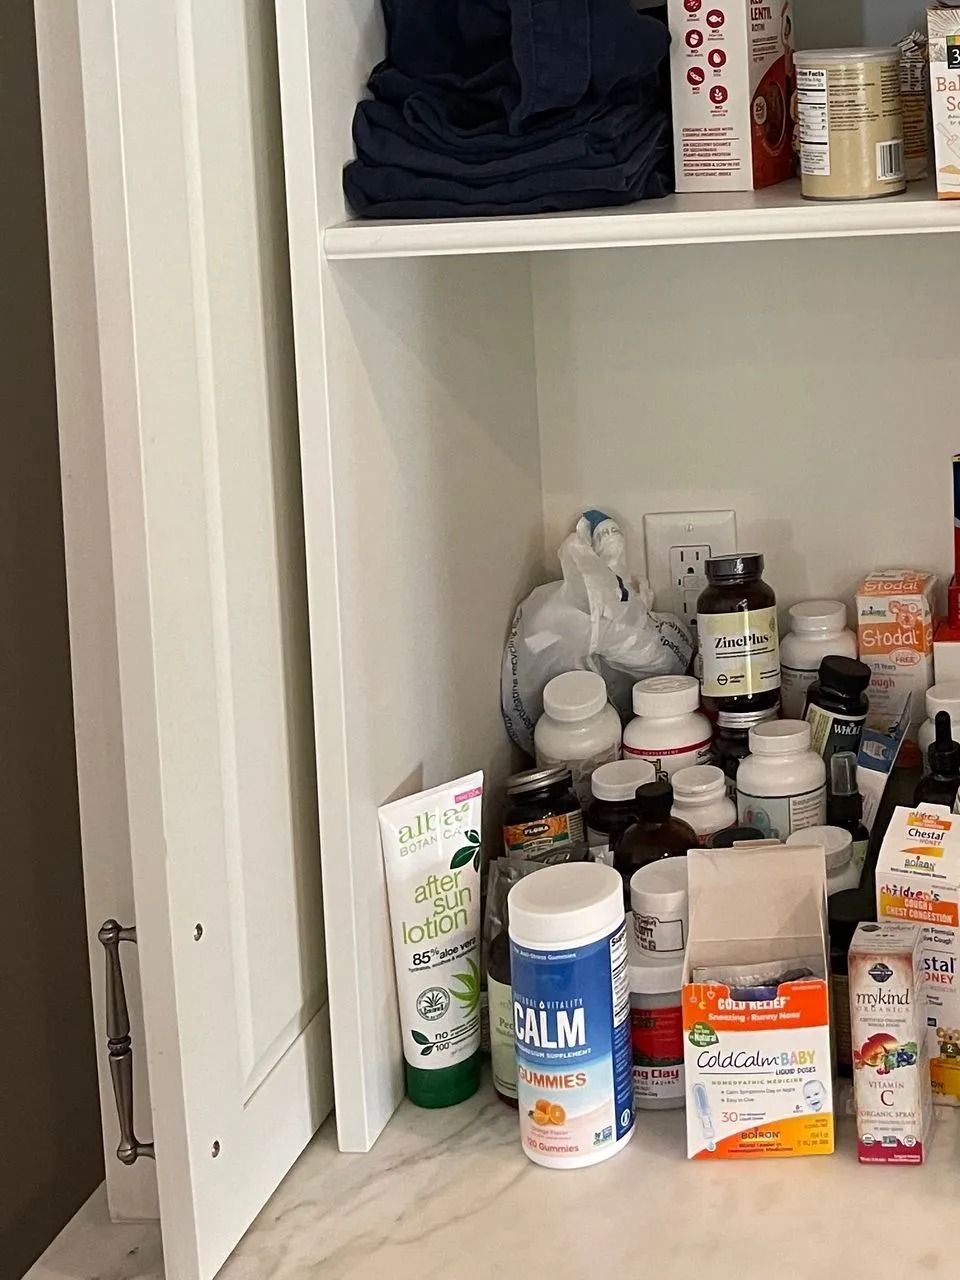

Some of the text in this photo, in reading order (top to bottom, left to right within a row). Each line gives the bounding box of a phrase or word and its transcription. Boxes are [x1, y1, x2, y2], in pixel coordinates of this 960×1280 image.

[750, 7, 772, 21] LENTIL
[864, 580, 918, 591] Stodal
[714, 633, 769, 649] ZincPlus
[862, 629, 919, 647] Stodal
[895, 656, 916, 664] FREE
[908, 828, 944, 841] Chestal
[414, 870, 463, 904] after
[880, 883, 941, 902] children's
[433, 887, 472, 916] sun
[904, 899, 928, 910] COUGH
[886, 906, 953, 924] CHEST CONGESTION
[402, 908, 469, 945] lotion
[930, 927, 955, 937] Formula
[933, 936, 953, 945] Cough
[412, 948, 441, 967] 85%
[439, 945, 459, 960] aloe
[547, 952, 577, 961] Gummies
[924, 956, 955, 973] stal
[546, 997, 583, 1010] VITALITY
[717, 997, 787, 1010] COLD RELIEF
[856, 988, 910, 1009] mykind
[708, 1011, 801, 1023] Sneezing Runny Nose
[513, 1001, 586, 1049] CALM
[435, 1030, 449, 1041] no
[694, 1033, 717, 1042] Natural
[546, 1047, 592, 1059] SUPPLEMENT
[947, 1044, 953, 1053] 2
[697, 1050, 816, 1069] ColdCalm BABY
[651, 1069, 679, 1081] Clay
[775, 1066, 816, 1075] LIQUID DOSES
[518, 1067, 587, 1090] GUMMIES
[869, 1080, 905, 1090] VITAMIN
[880, 1090, 894, 1107] C
[721, 1111, 738, 1123] 30
[895, 1110, 916, 1118] SPRAY
[741, 1127, 780, 1140] BOIRON
[538, 1142, 579, 1153] Gummies
